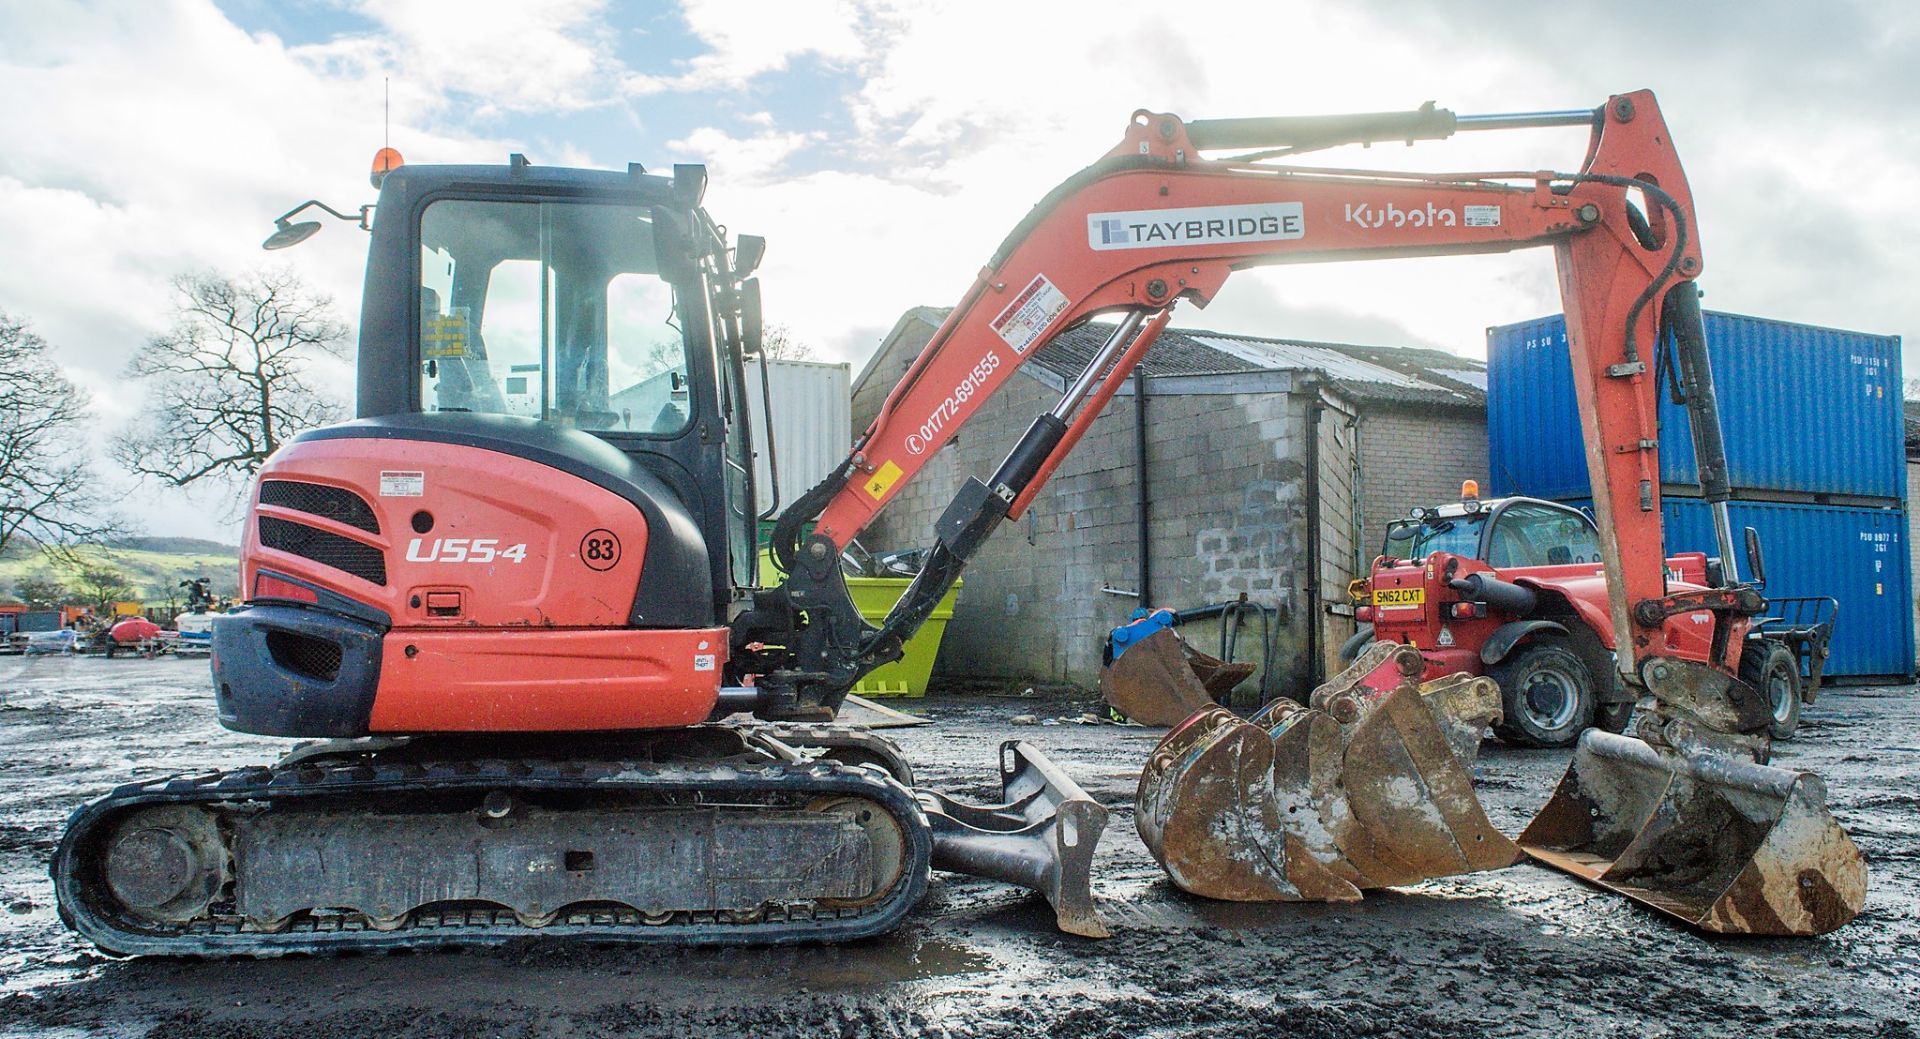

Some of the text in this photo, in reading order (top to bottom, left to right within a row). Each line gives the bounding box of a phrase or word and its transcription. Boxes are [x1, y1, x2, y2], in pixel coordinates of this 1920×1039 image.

[1345, 202, 1456, 228] Kubota
[1129, 215, 1299, 242] TAYBRIDGE
[920, 351, 1000, 441] 01772-691555
[405, 538, 527, 564] U55-4
[587, 538, 614, 561] 83
[1377, 589, 1421, 603] SN62 CXT
